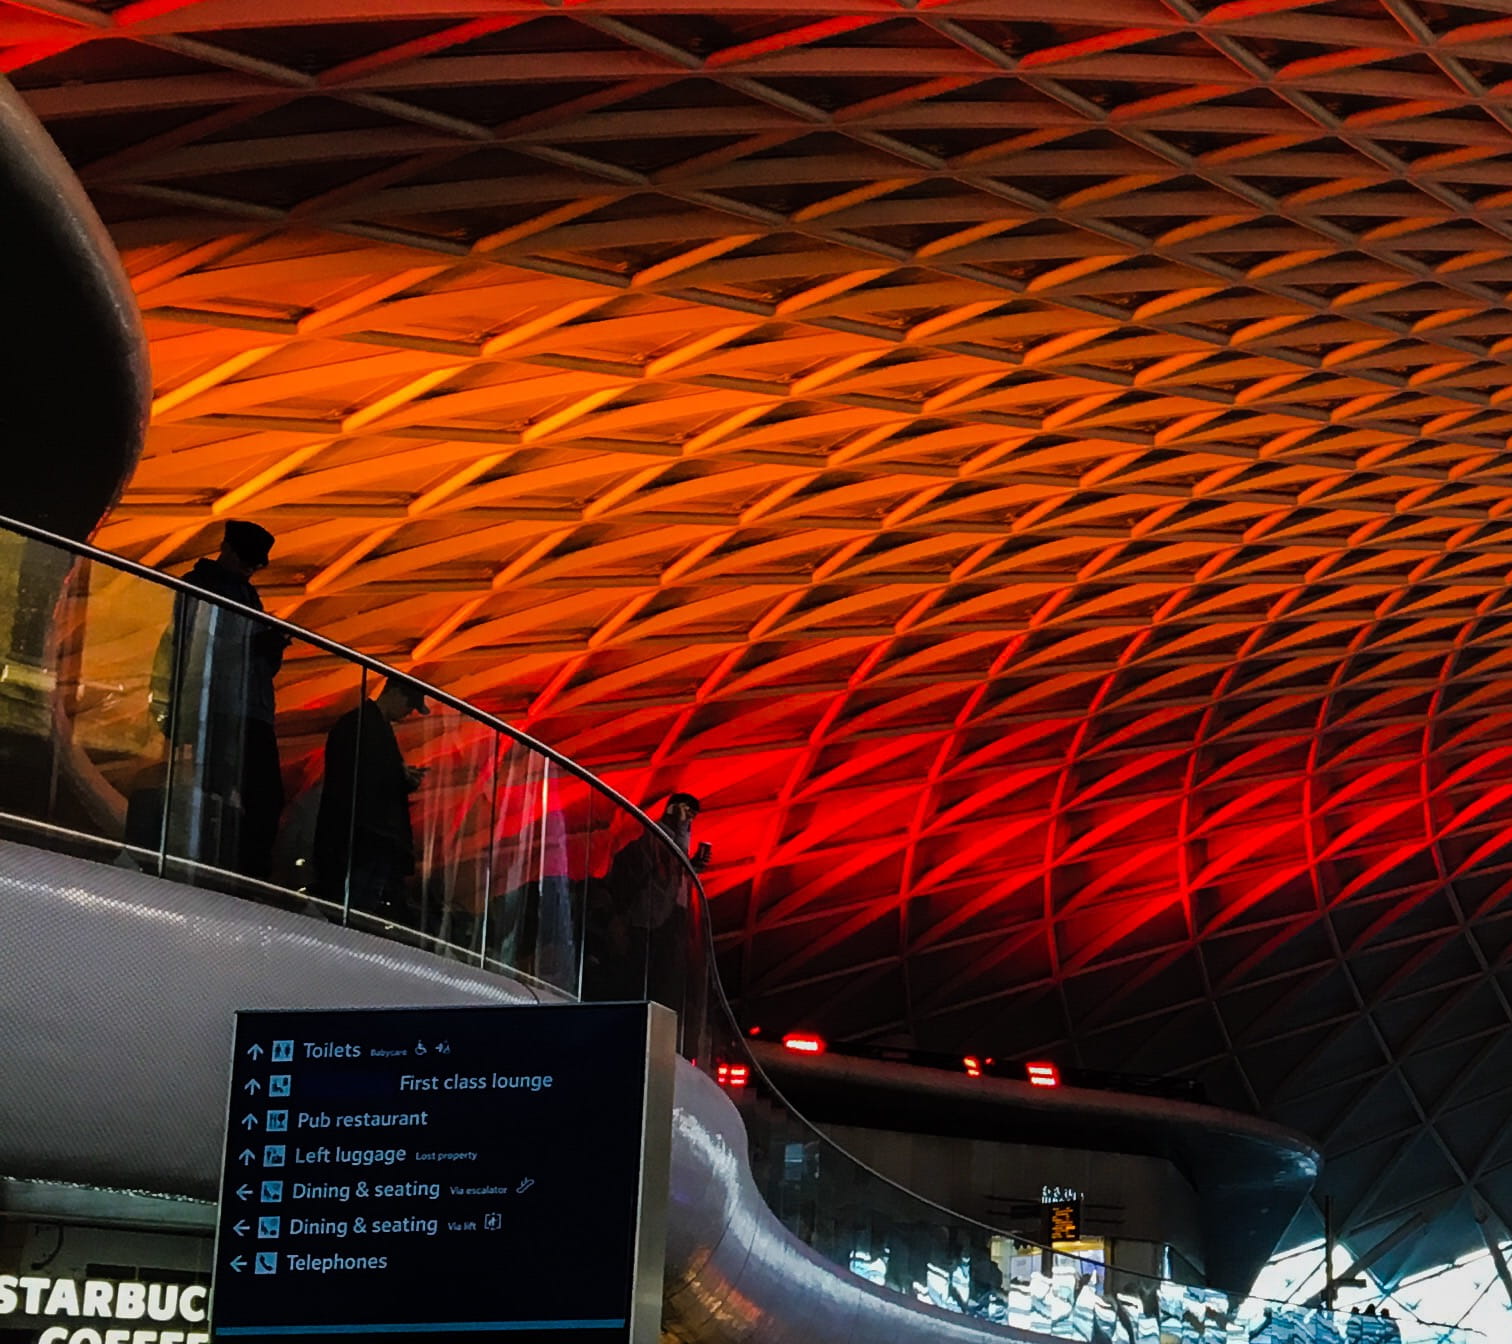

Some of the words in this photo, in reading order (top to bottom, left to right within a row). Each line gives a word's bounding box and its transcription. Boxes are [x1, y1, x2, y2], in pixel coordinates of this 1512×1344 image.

[303, 1042, 362, 1058] Toilets
[400, 1074, 439, 1091] First
[443, 1073, 487, 1089] class
[492, 1072, 553, 1092] lounge
[298, 1112, 331, 1128] Pub
[336, 1111, 428, 1127] restaurant
[295, 1146, 331, 1163] Left
[335, 1146, 407, 1166] luggage
[415, 1152, 436, 1161] Lost
[437, 1152, 478, 1161] property
[292, 1182, 351, 1202] Dining
[355, 1181, 370, 1197] &
[374, 1180, 440, 1199] seating
[449, 1186, 465, 1195] Via
[466, 1184, 508, 1195] escalator
[289, 1218, 348, 1238] Dining
[353, 1217, 367, 1233] &
[371, 1216, 438, 1236] seating
[447, 1222, 462, 1231] Via
[463, 1221, 477, 1231] lift
[286, 1253, 388, 1273] Telephones
